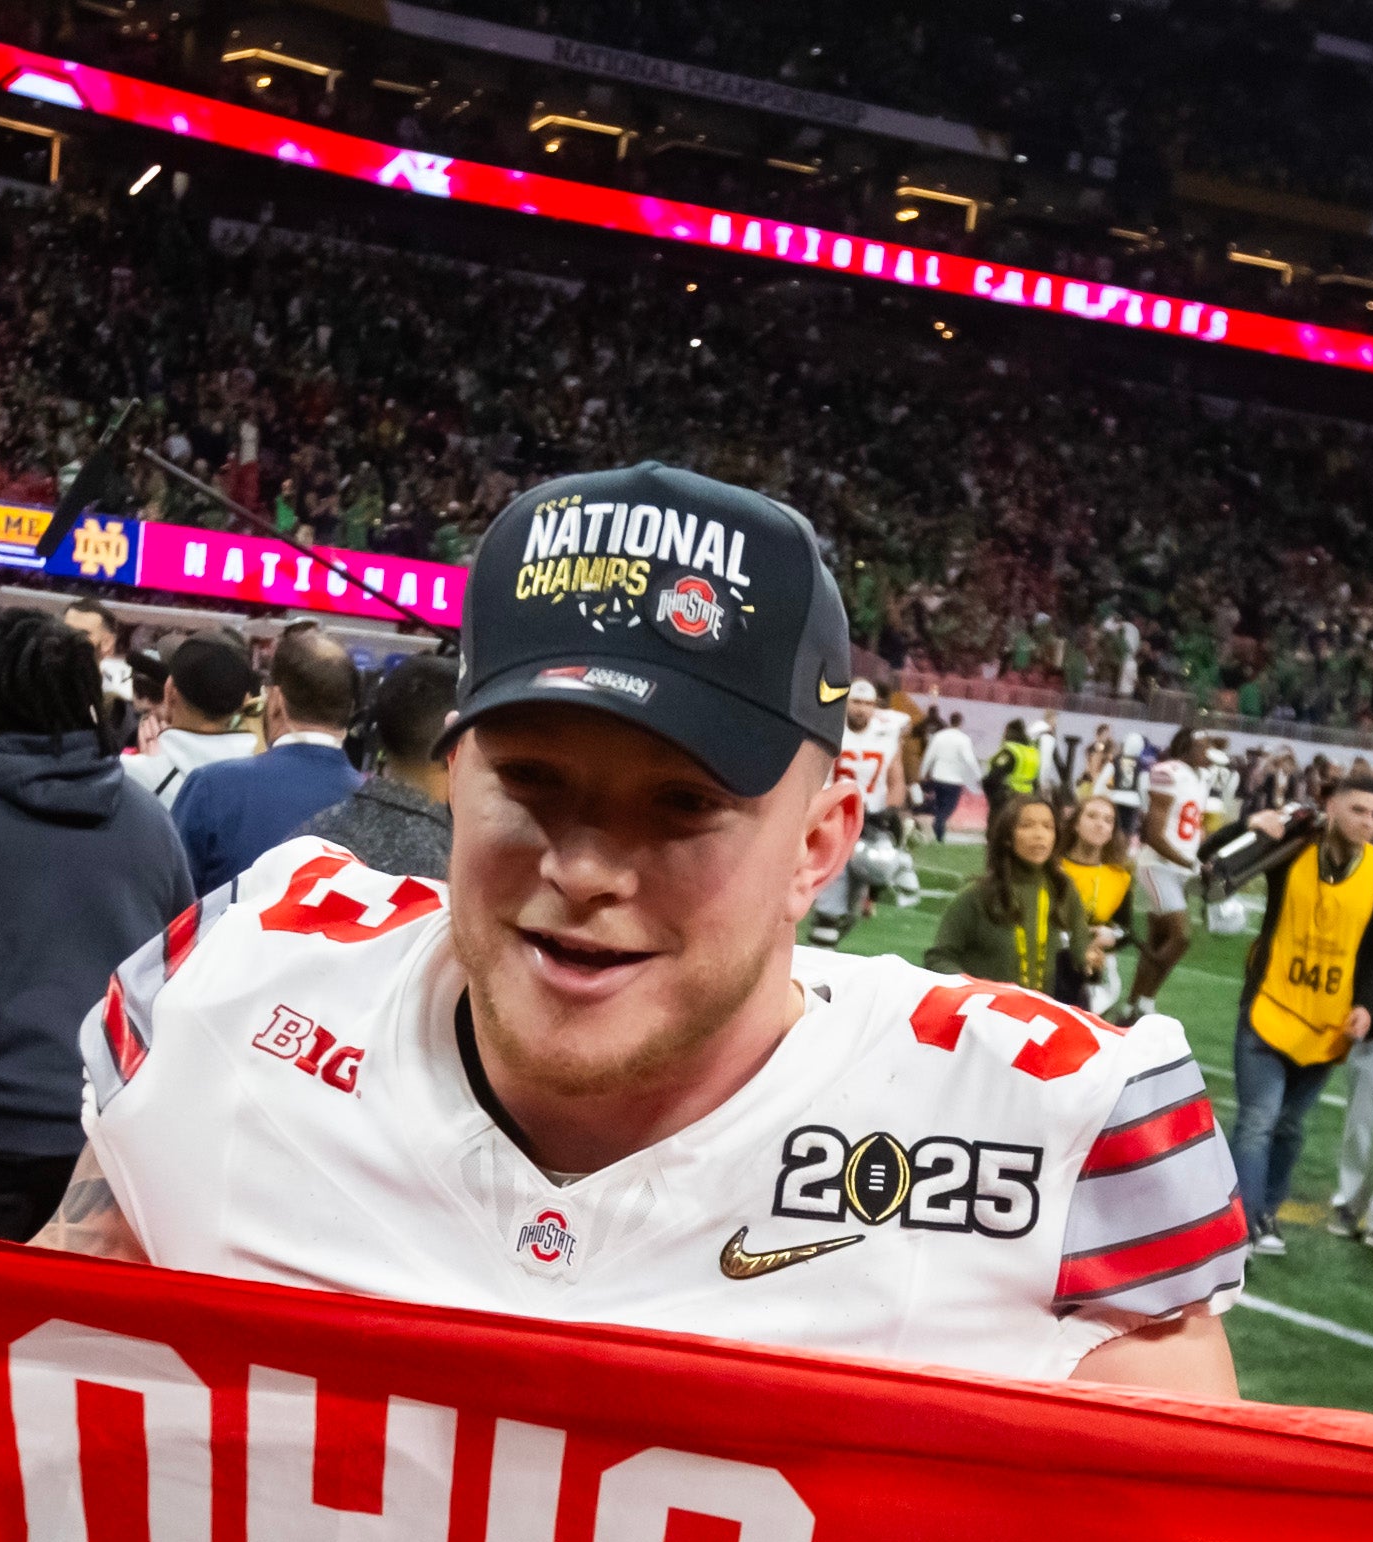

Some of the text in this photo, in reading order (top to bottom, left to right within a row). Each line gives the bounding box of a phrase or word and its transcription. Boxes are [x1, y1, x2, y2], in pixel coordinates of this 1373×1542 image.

[709, 213, 940, 286] NATIONAL
[183, 541, 448, 611] NATIONAL
[515, 556, 651, 600] CHAMPS
[522, 502, 751, 588] NATIONAL
[1288, 955, 1344, 996] 048
[772, 1125, 1044, 1240] 2025
